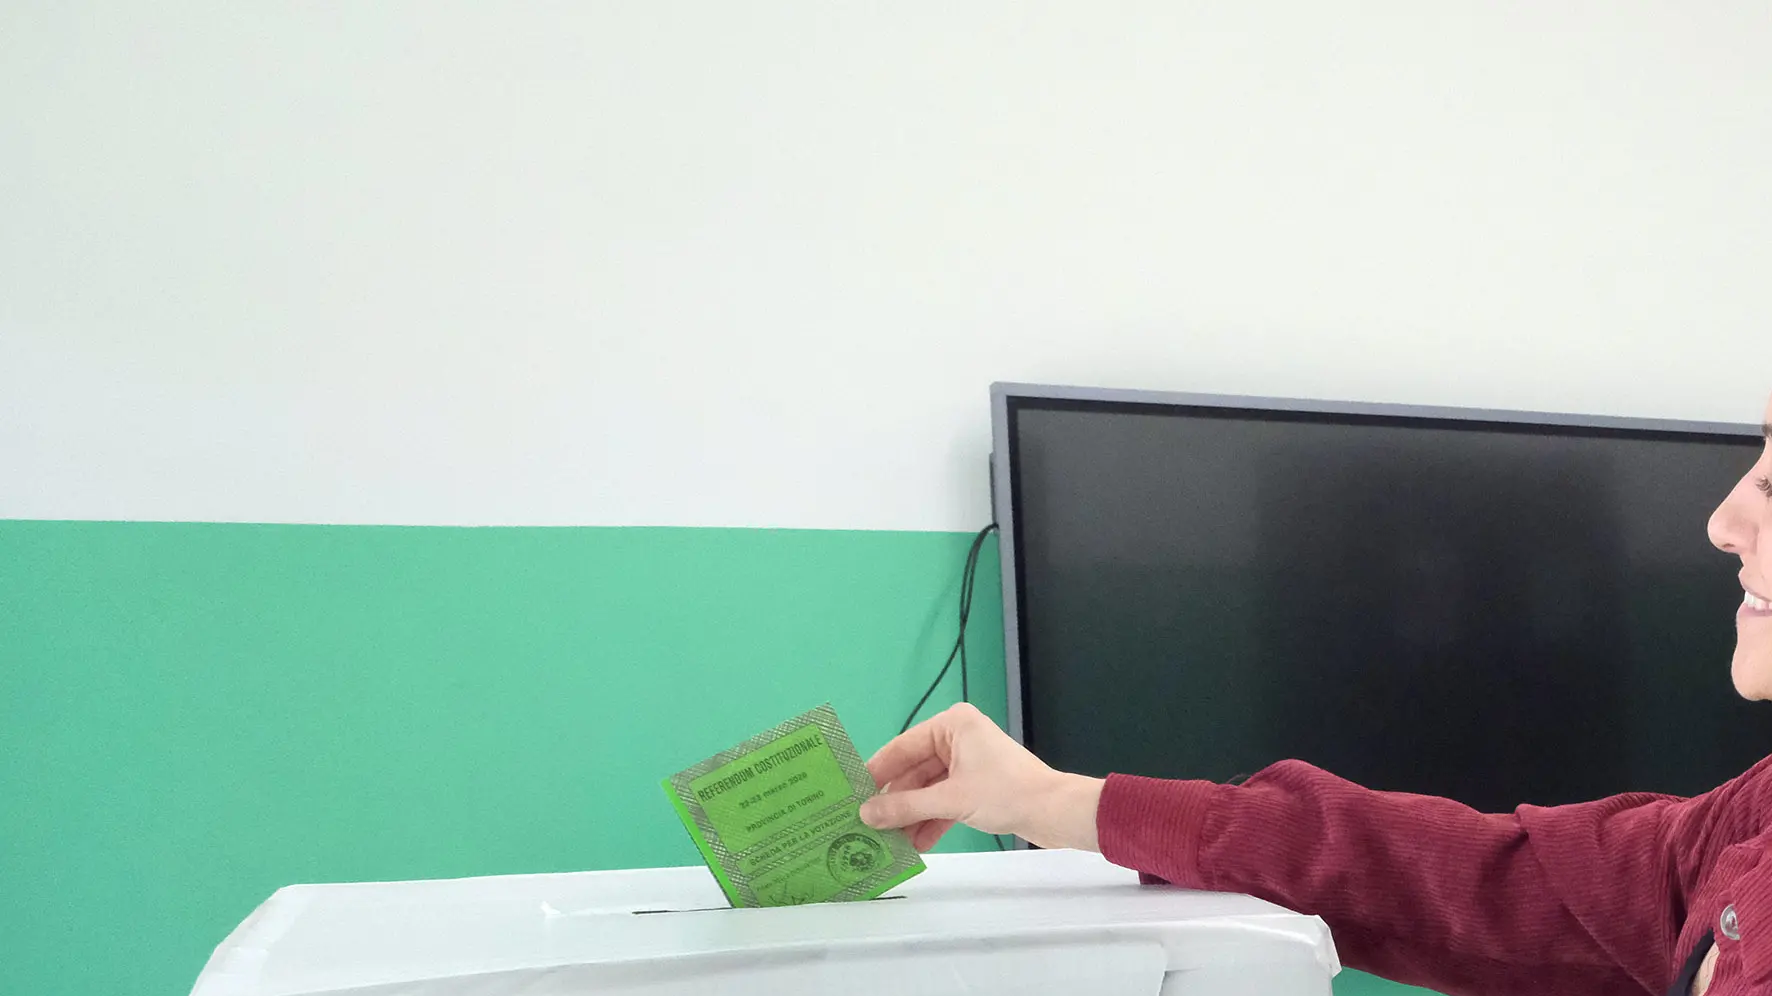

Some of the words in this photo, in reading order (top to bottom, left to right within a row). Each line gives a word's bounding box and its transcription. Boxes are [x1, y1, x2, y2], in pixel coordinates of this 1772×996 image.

[698, 768, 755, 802] REFERENDUM
[755, 734, 823, 774] COSTITUZIONALE
[746, 810, 787, 833] PROVINCIA
[787, 803, 796, 813] DI
[796, 790, 824, 808] TORINO
[750, 846, 782, 866] SCHEDA
[782, 837, 797, 849] PER
[810, 811, 852, 834] VOTAZIONE
